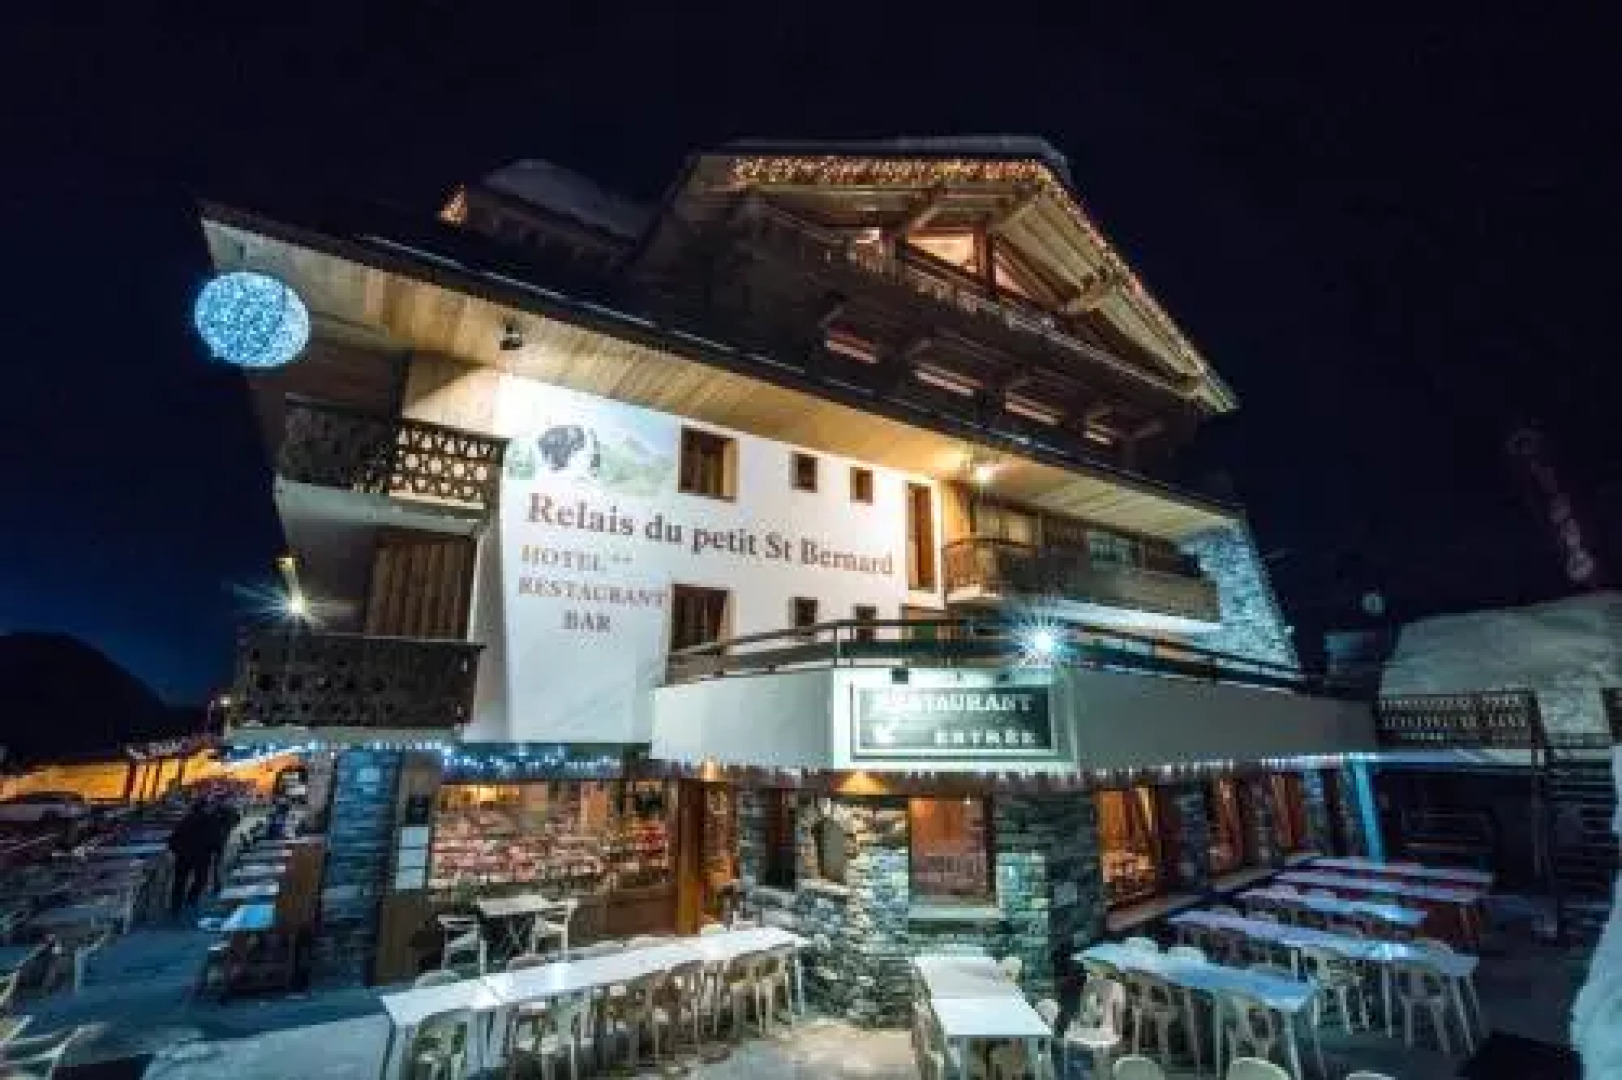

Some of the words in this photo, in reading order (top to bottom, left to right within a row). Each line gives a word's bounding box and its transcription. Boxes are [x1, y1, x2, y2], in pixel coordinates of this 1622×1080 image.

[528, 492, 634, 537] Relais
[644, 514, 683, 546] du
[690, 525, 758, 556] petit
[765, 531, 792, 563] St
[800, 537, 894, 576] Bernard
[521, 544, 607, 571] HOTEL
[562, 609, 611, 633] BAR
[873, 693, 1033, 712] TAURANT
